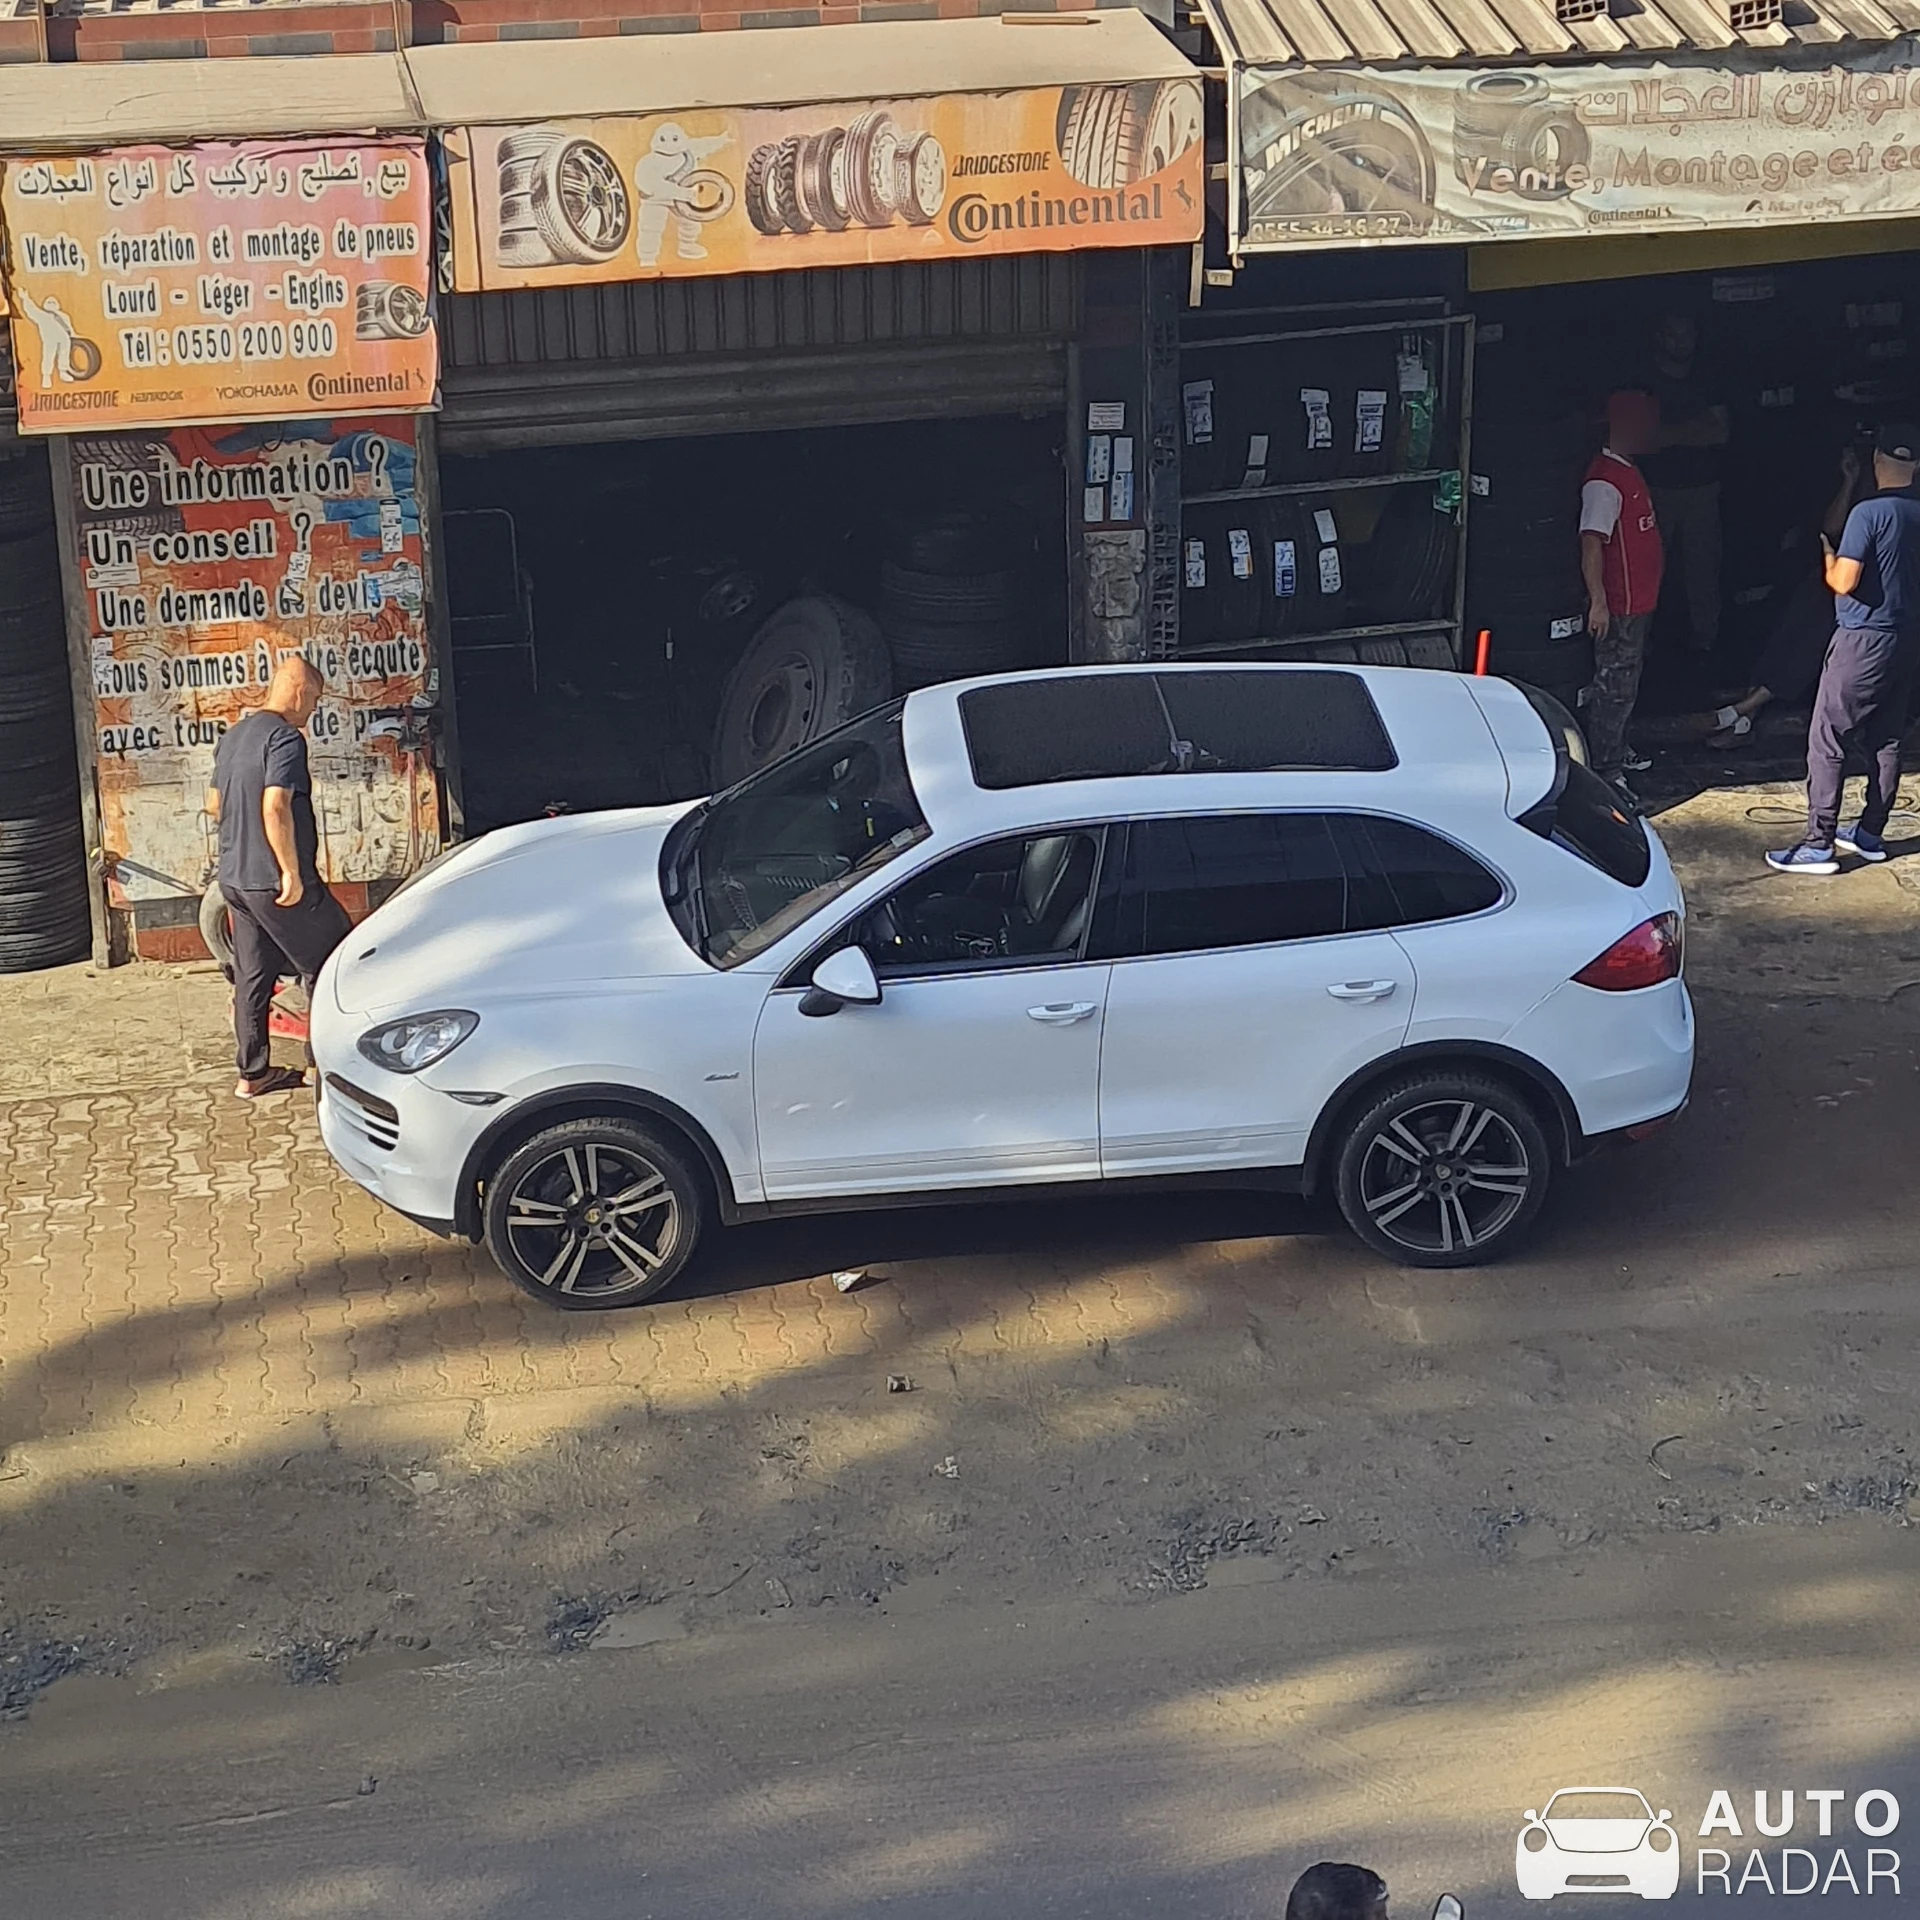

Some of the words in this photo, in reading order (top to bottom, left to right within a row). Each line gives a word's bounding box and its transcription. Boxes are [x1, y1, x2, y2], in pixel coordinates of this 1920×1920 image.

[1265, 103, 1374, 171] MICHELIN
[18, 162, 93, 201] العجلات
[170, 157, 195, 194] كل
[952, 151, 1050, 177] BRIDGESTONE
[1461, 156, 1605, 196] Vente,
[1613, 146, 1819, 192] Montage
[1827, 142, 1873, 175] et
[948, 183, 1162, 244] Continental
[1588, 206, 1661, 224] Continental
[25, 236, 86, 271] Vente,
[102, 229, 195, 271] réparation
[212, 228, 230, 258] et
[247, 226, 320, 261] montage
[337, 222, 356, 252] de
[366, 227, 415, 258] pneus
[107, 282, 156, 313] Lourd
[203, 278, 249, 315] Léger
[289, 274, 344, 310] Engins
[177, 329, 231, 359] 0550
[243, 325, 282, 356] 200
[294, 323, 333, 353] 900
[217, 383, 298, 400] YOKOHAMA
[307, 369, 410, 402] Continental
[85, 467, 144, 506] Une
[162, 454, 349, 502] information
[369, 440, 385, 487] ?
[91, 532, 133, 565] Un
[153, 522, 272, 561] conseil
[101, 591, 145, 627] Une
[160, 582, 266, 623] demande
[161, 655, 245, 690] sommes
[258, 643, 269, 682] à
[103, 725, 160, 753] avec
[313, 706, 339, 737] de
